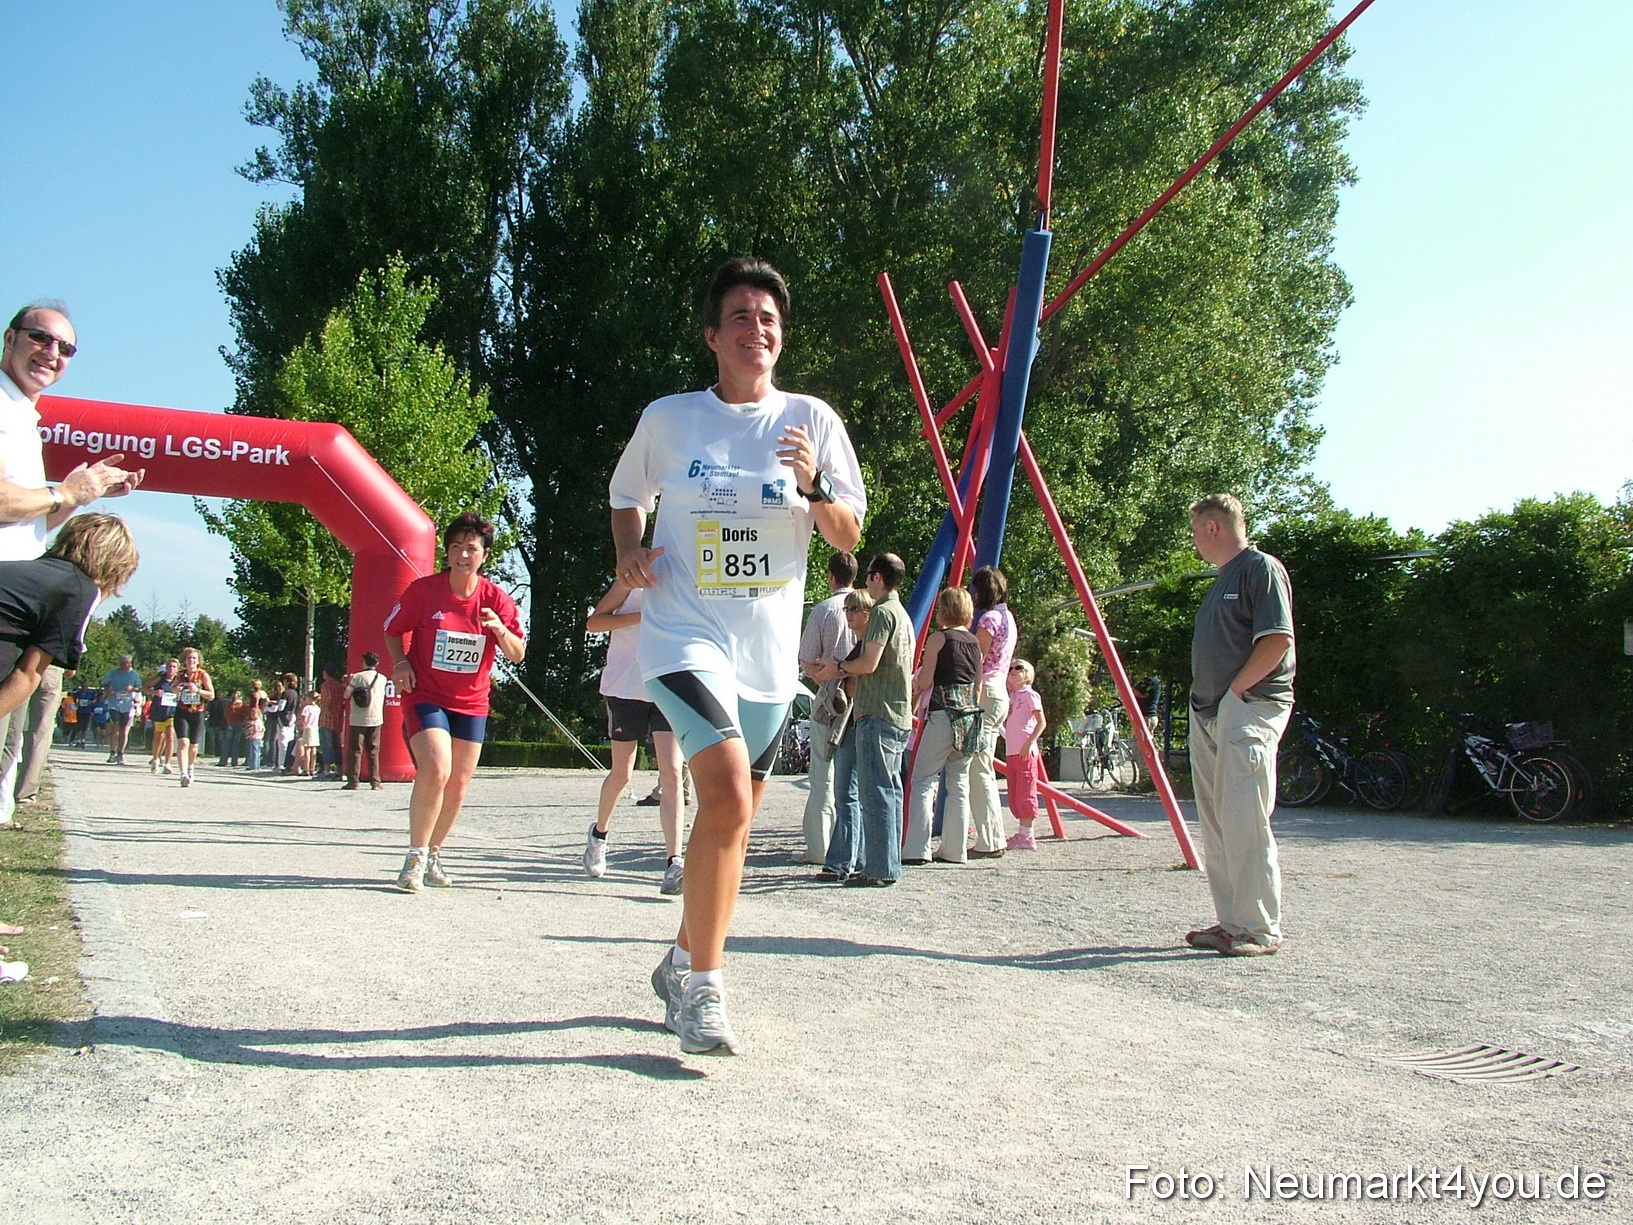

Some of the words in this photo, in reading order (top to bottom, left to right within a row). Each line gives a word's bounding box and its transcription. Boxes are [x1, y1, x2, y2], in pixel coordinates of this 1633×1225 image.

[165, 434, 290, 465] LGS-Park
[688, 459, 705, 478] 6.
[709, 470, 740, 478] Stadtlauf
[762, 497, 783, 505] DKMS
[722, 527, 758, 542] Doris
[703, 549, 714, 562] D
[725, 553, 770, 577] 851
[436, 644, 443, 652] D
[447, 635, 477, 647] Josefine
[446, 648, 480, 663] 2720
